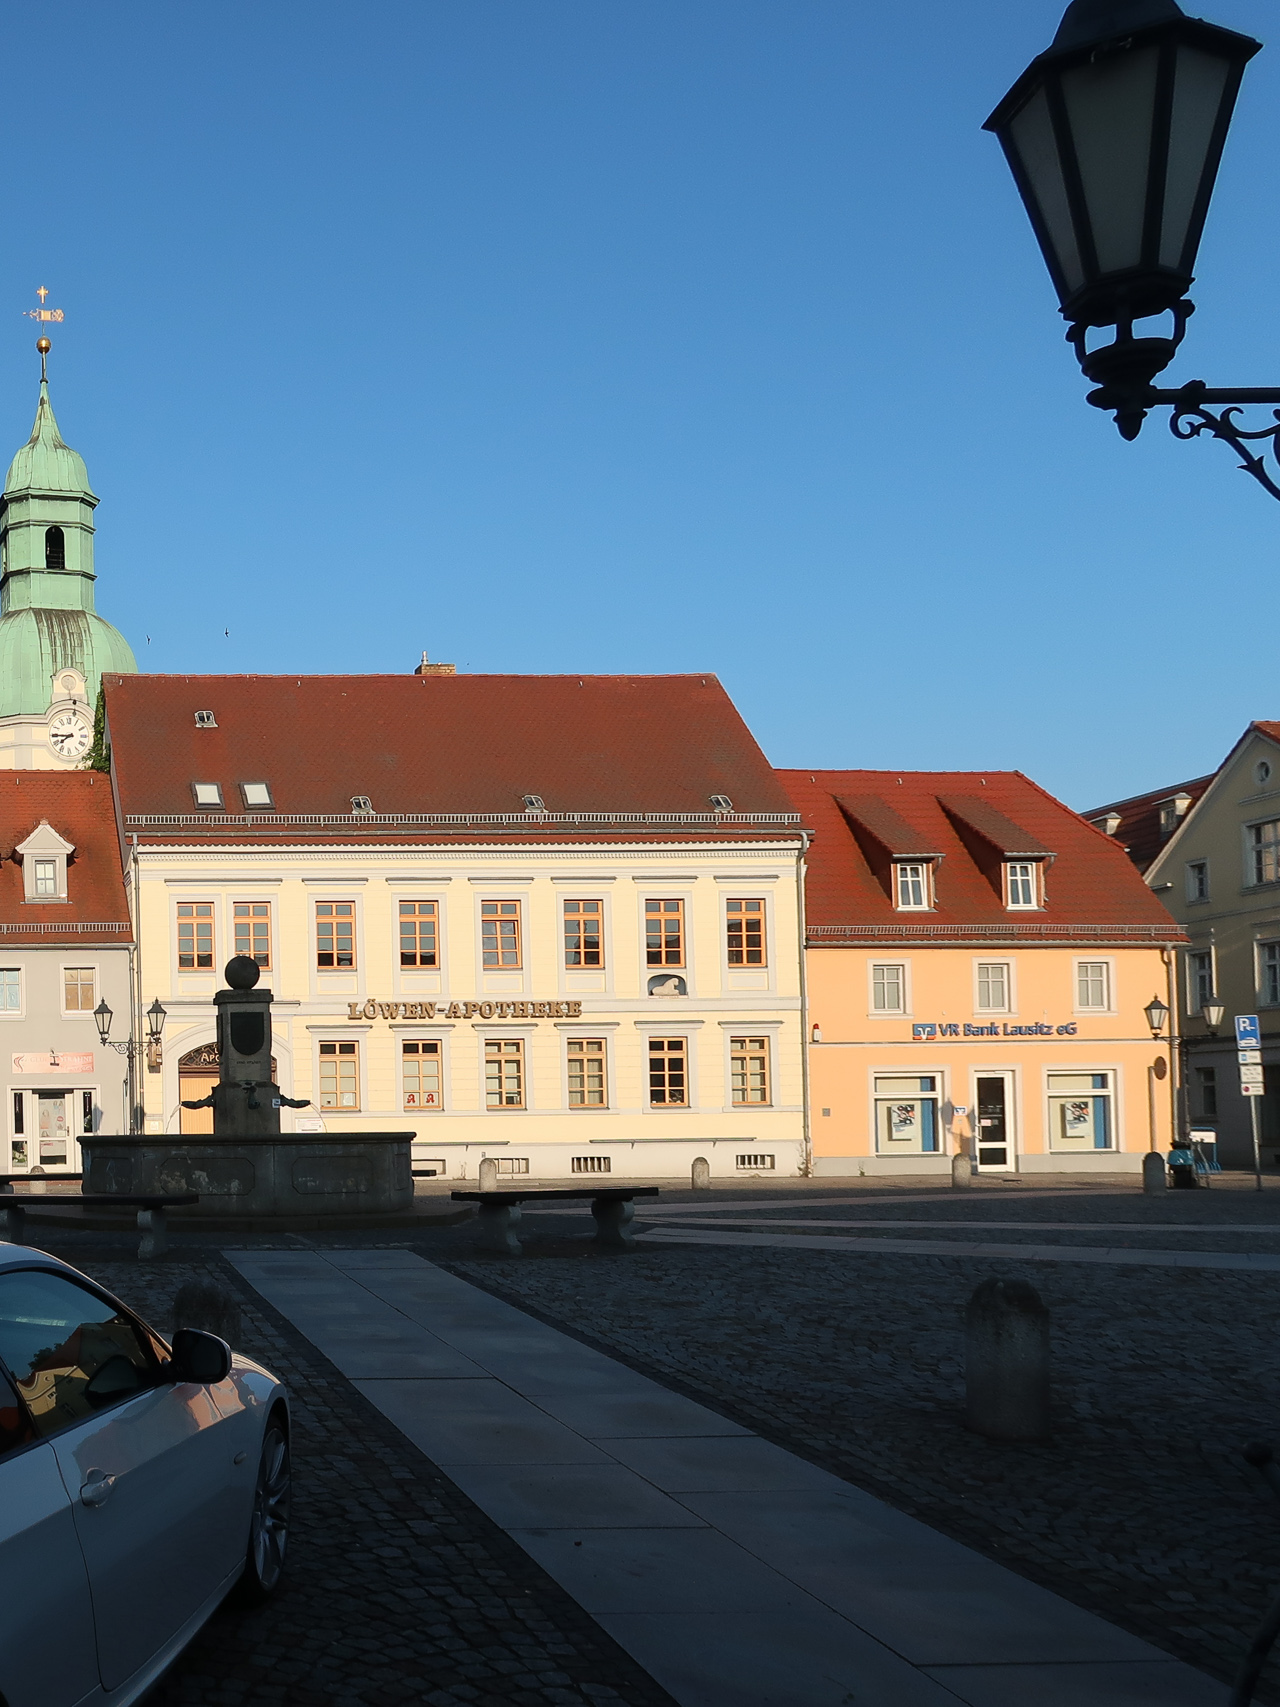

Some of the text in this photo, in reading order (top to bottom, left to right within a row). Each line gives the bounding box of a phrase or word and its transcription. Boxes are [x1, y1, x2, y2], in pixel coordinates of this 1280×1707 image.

[347, 998, 583, 1020] LÖWEN-APOTHEKE
[938, 1021, 1077, 1036] VR Bank Lausitz eG
